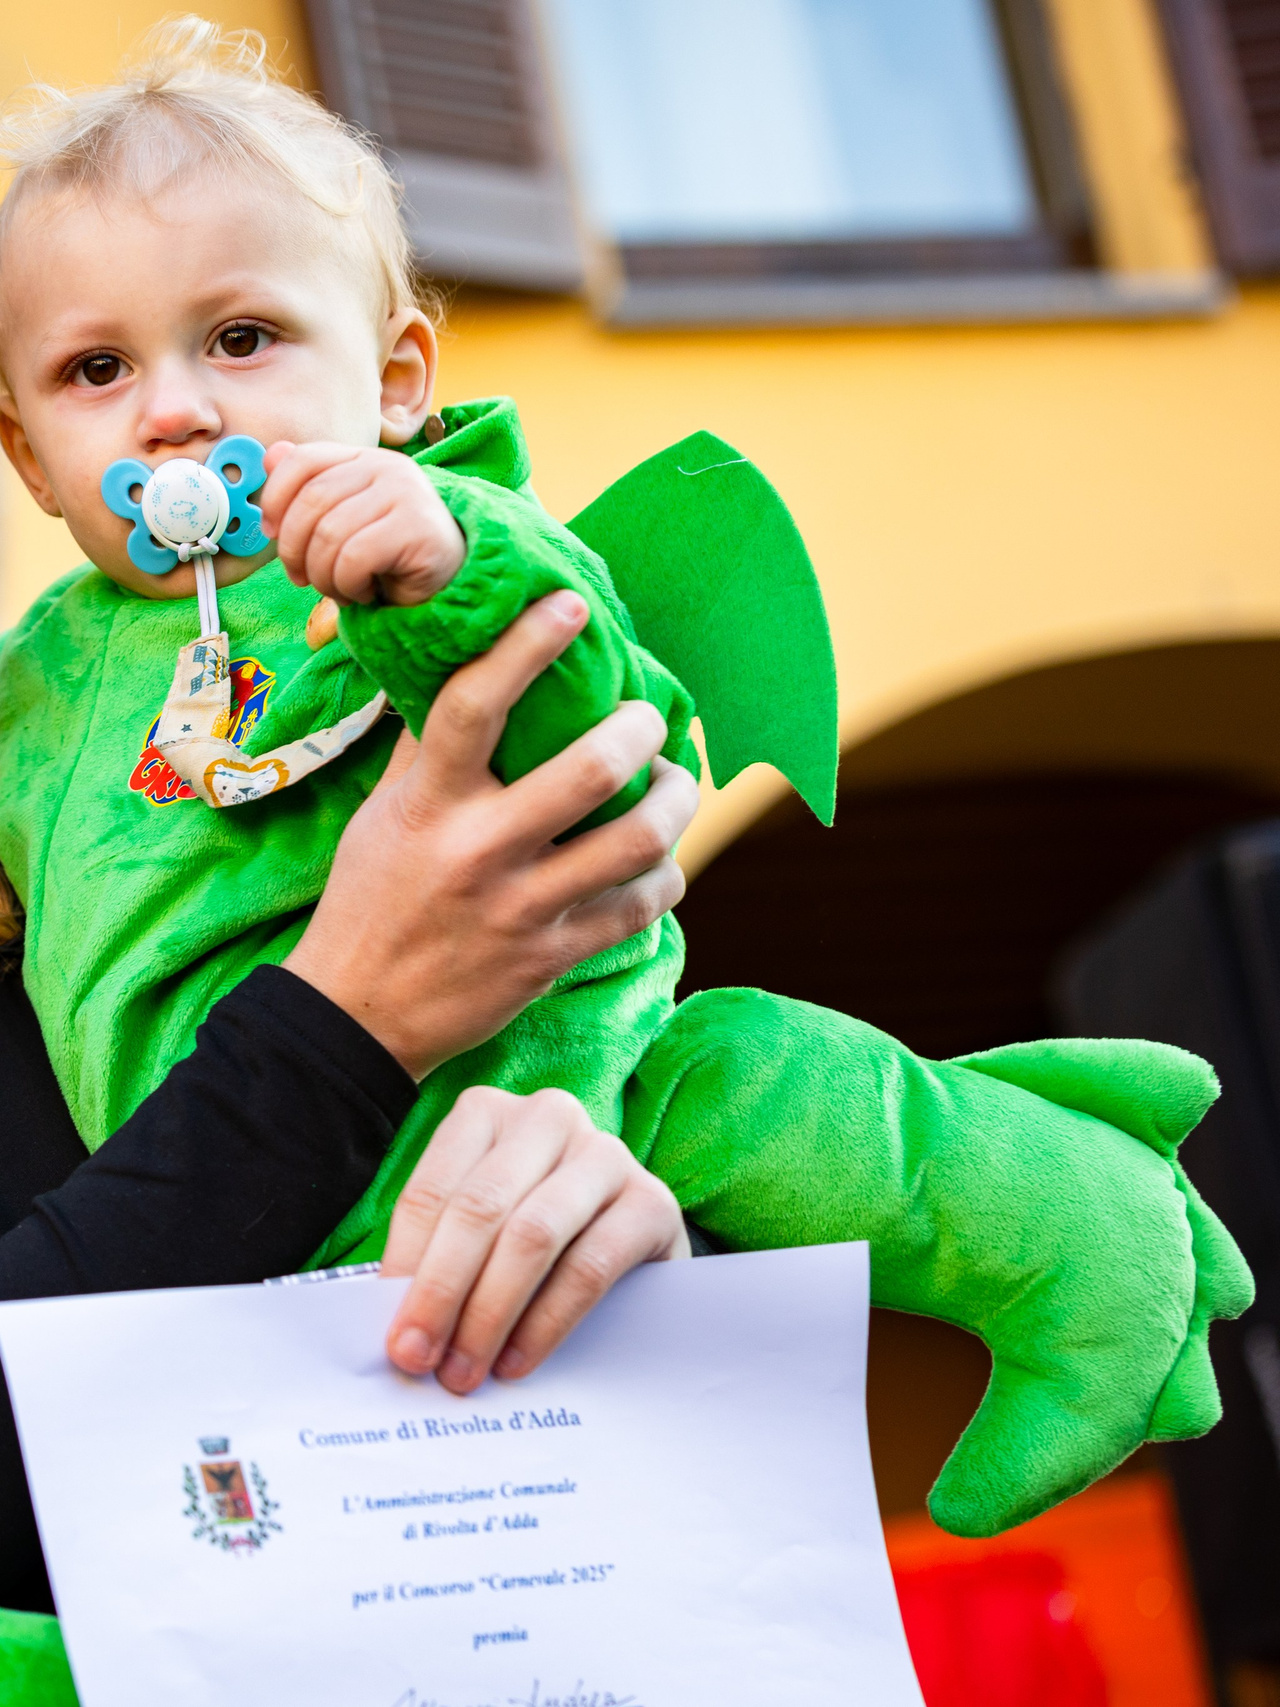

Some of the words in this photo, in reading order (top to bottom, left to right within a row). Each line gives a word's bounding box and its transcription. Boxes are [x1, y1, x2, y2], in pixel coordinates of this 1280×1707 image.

[298, 1428, 391, 1448] Comune
[396, 1421, 420, 1441] di
[423, 1414, 503, 1439] Rivolta
[508, 1406, 582, 1431] d'Adda
[342, 1487, 496, 1514] L'Amministrazione
[500, 1477, 578, 1500] Comunale
[402, 1521, 419, 1541] di
[423, 1518, 479, 1538] Rivolta
[483, 1511, 540, 1533] d'Adda
[351, 1588, 379, 1609] per
[384, 1583, 395, 1602] il
[398, 1580, 476, 1601] Concorso
[472, 1624, 529, 1651] premia
